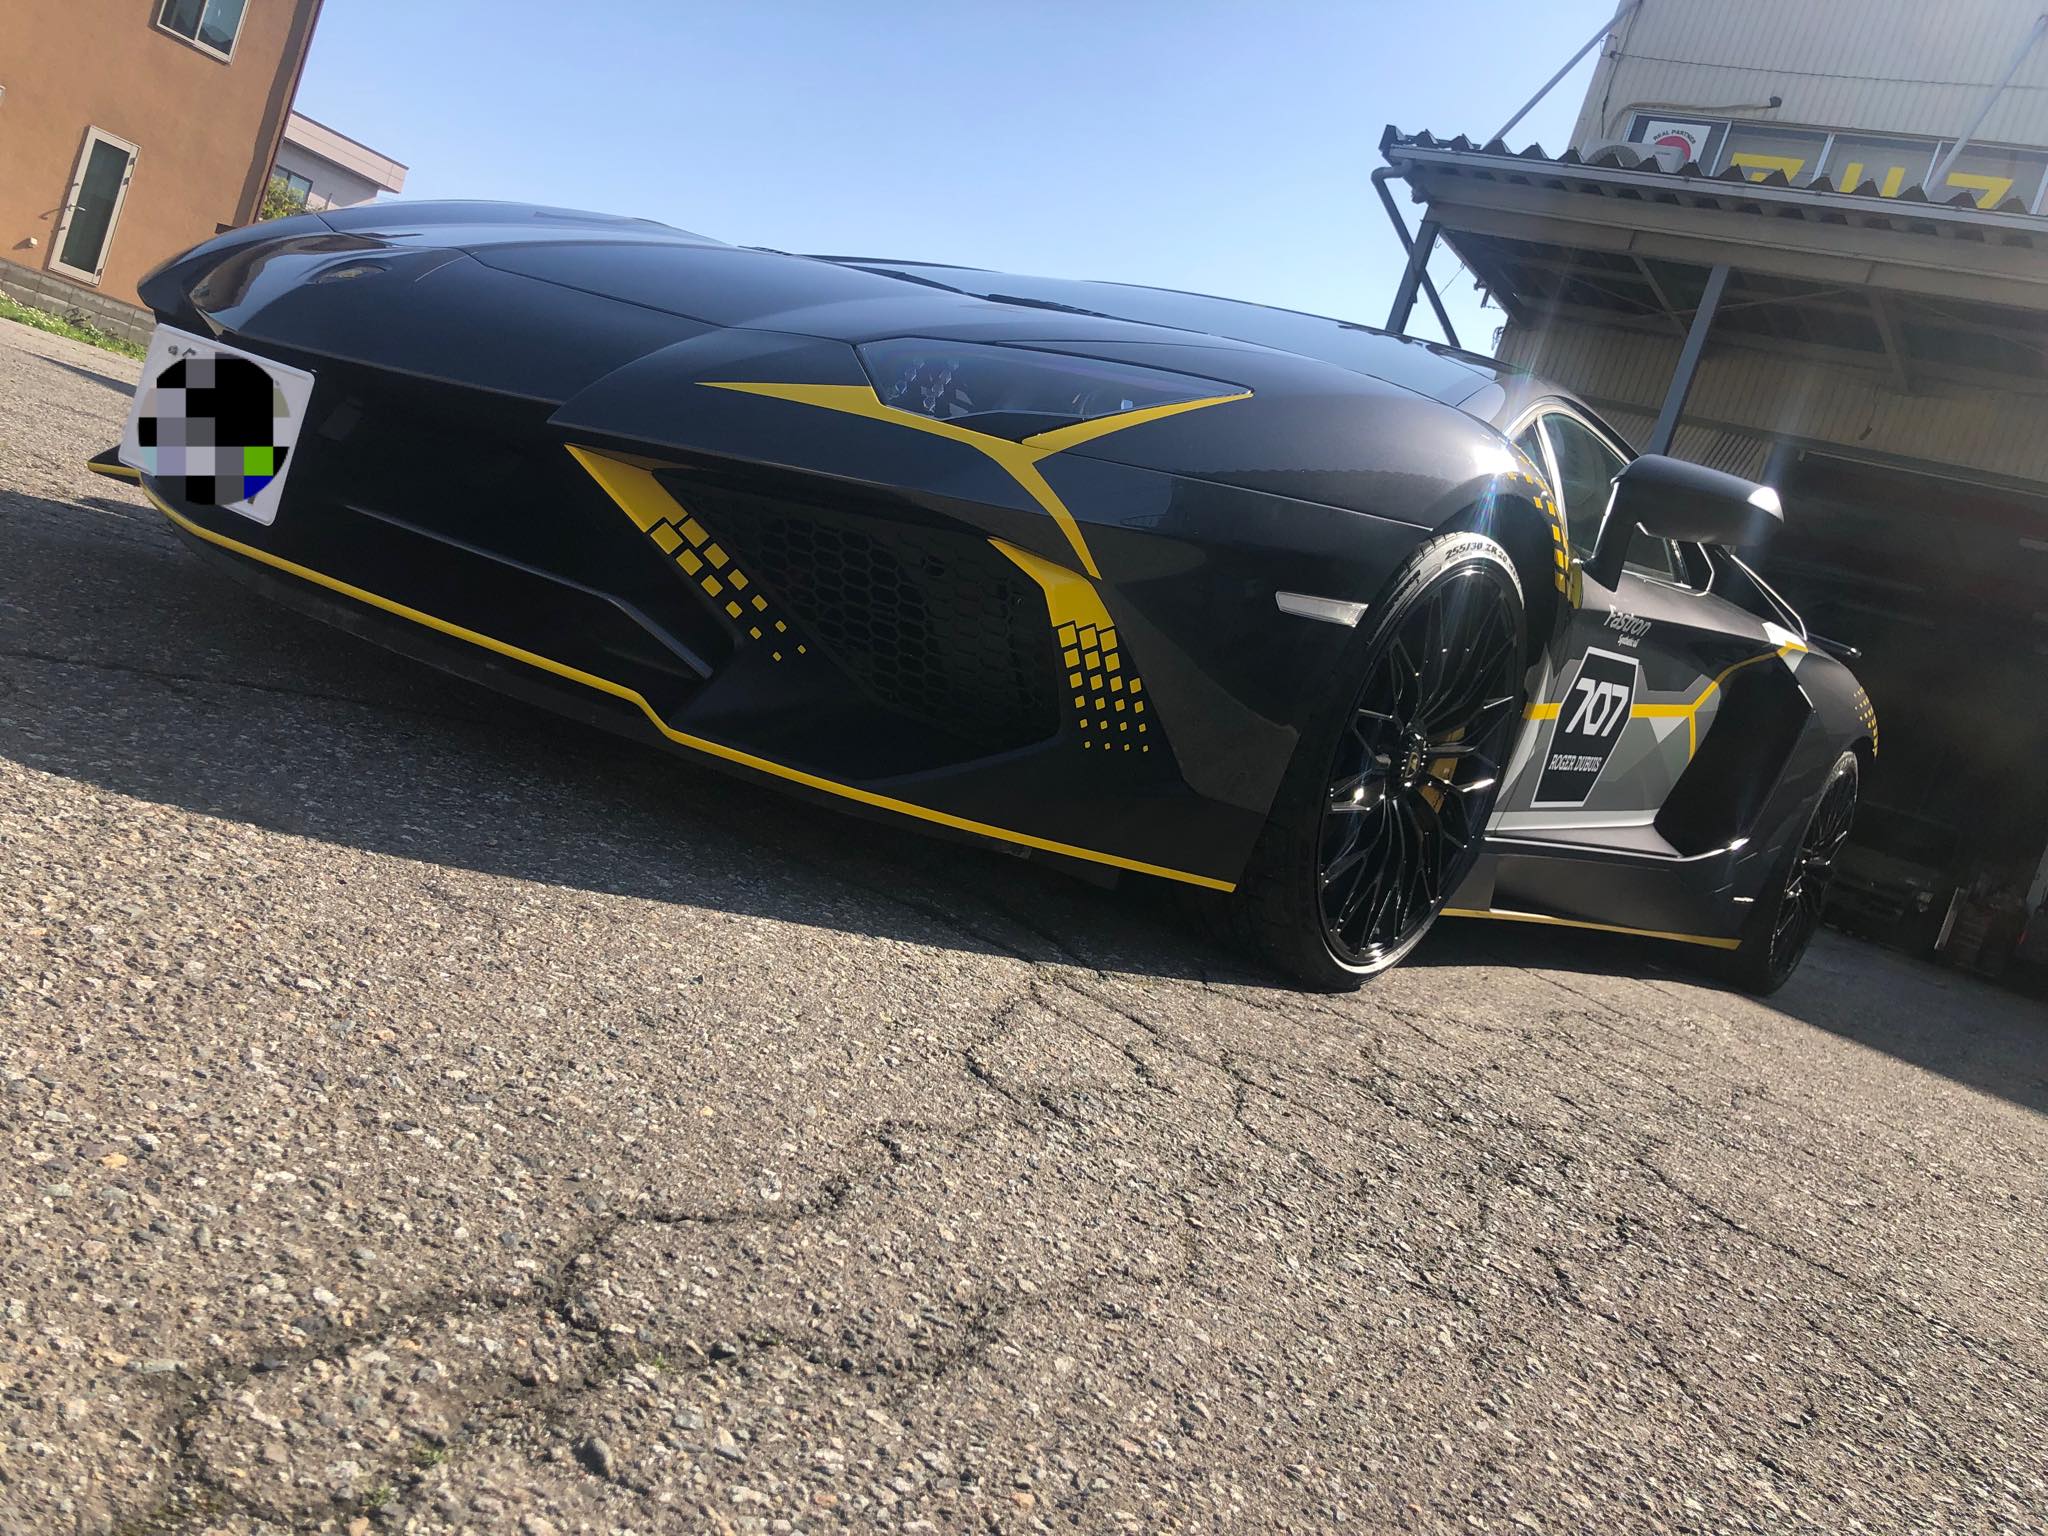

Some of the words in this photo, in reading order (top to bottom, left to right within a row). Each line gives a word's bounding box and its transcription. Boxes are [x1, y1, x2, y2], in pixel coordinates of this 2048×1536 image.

[1653, 130, 1669, 141] REAL
[1445, 542, 1483, 560] 255/30
[1603, 604, 1651, 637] Fastron
[1565, 677, 1630, 737] 707
[1548, 754, 1577, 771] ROGER
[1573, 755, 1602, 772] DUBUIS
